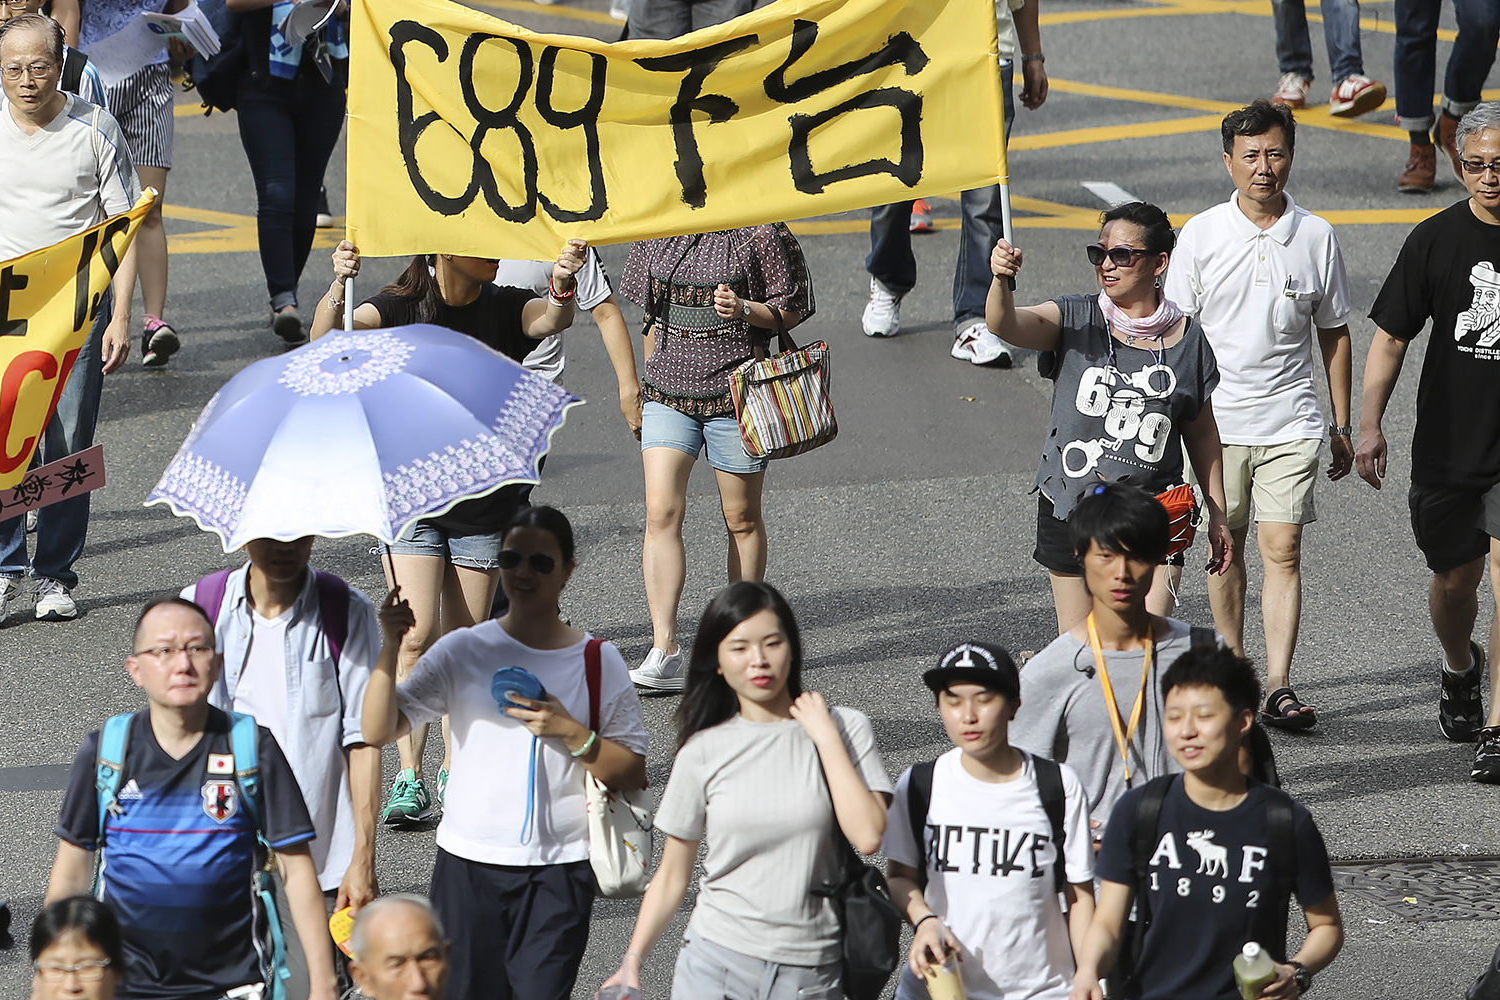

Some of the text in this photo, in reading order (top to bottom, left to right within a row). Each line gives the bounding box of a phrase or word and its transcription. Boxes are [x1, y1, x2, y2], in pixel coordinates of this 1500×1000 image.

[1075, 365, 1172, 464] 689
[1149, 831, 1268, 883] A F
